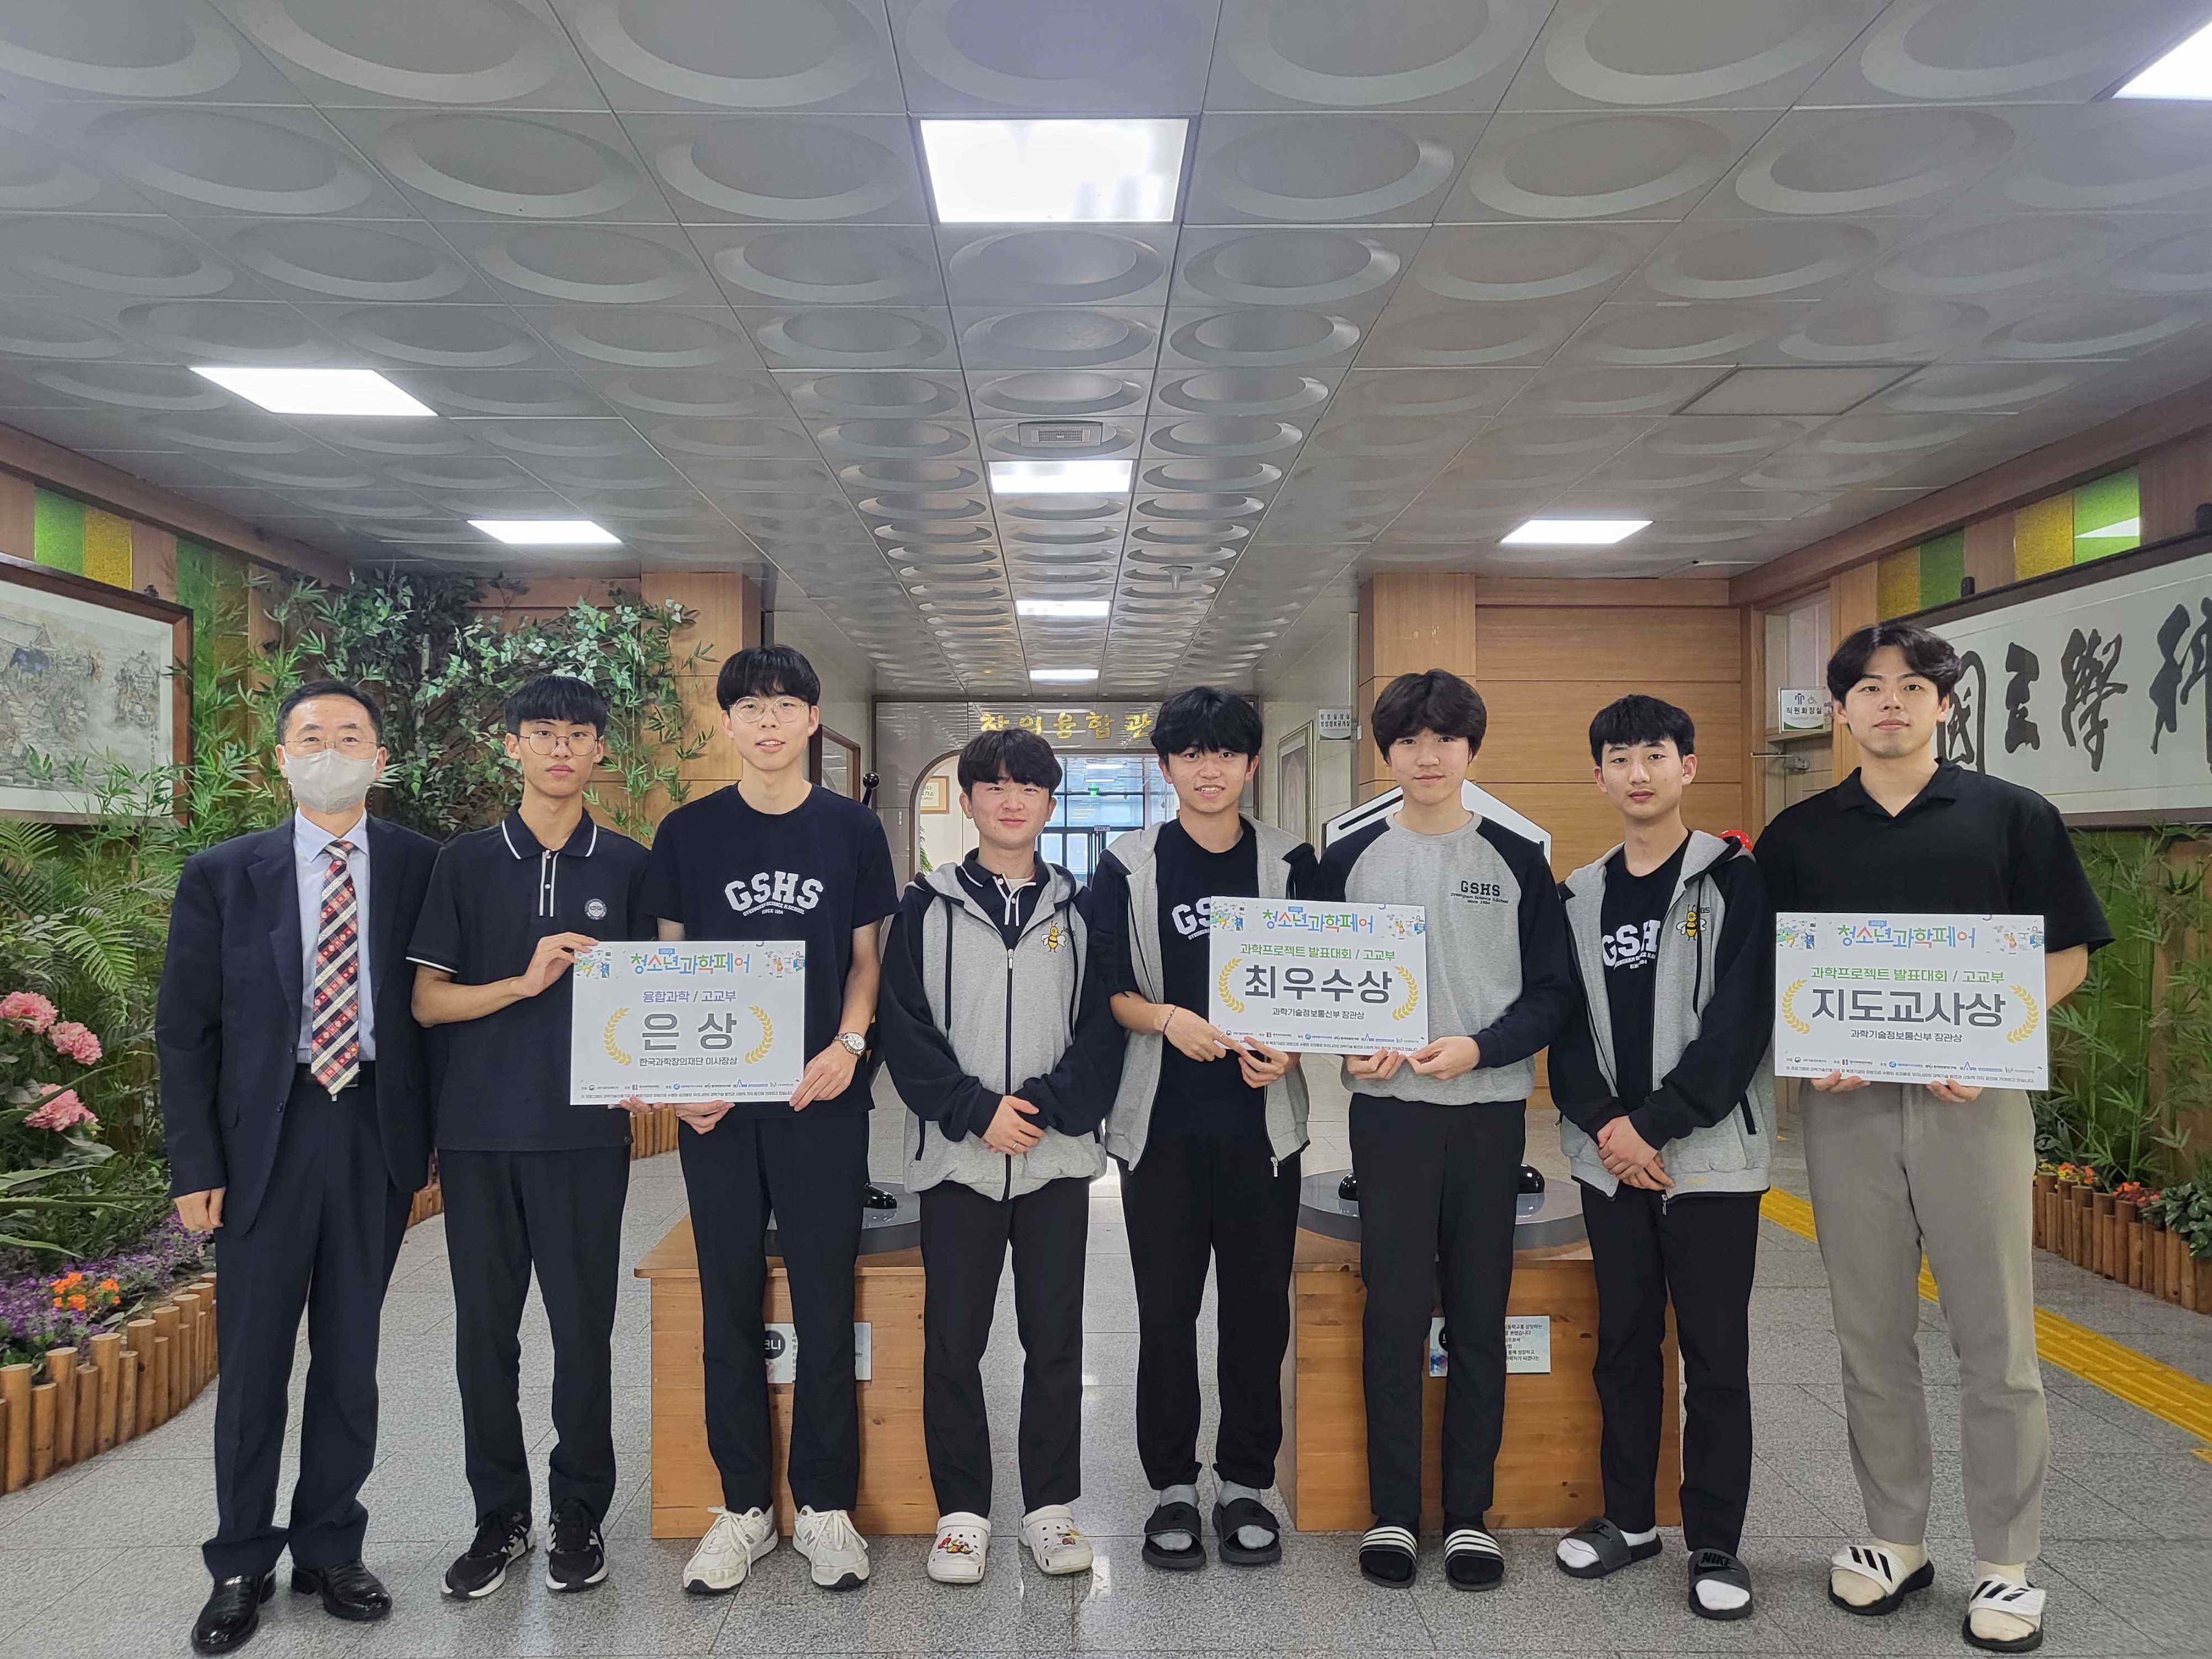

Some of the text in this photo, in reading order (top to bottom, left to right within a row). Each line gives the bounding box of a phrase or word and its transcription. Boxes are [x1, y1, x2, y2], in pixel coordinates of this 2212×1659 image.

[724, 871, 824, 911] GSHS
[1461, 880, 1500, 897] GSHS
[1262, 909, 1374, 934] 청소년과학페어
[1837, 924, 1977, 949] 청소년과학페어
[1240, 943, 1306, 957] 과학프로젝트
[1308, 945, 1352, 960] 발표대회
[1362, 949, 1396, 962] 고교부
[630, 952, 751, 975] 청소년과학페어
[1244, 964, 1393, 1004] 최우수상
[1811, 966, 1891, 981] 과학프로젝트
[1893, 968, 1948, 982] 발표대회
[1962, 970, 2005, 984] 고교부
[643, 990, 690, 1003] 융합과학
[701, 990, 737, 1003] 고교부
[1272, 1008, 1365, 1020] 과학기술정보통신부 장관상
[1811, 987, 2006, 1027] 지도교사상
[1849, 1029, 1963, 1042] 과학기술정보통신부 장관상
[639, 1056, 737, 1067] 한국과학창의재단 이사장상
